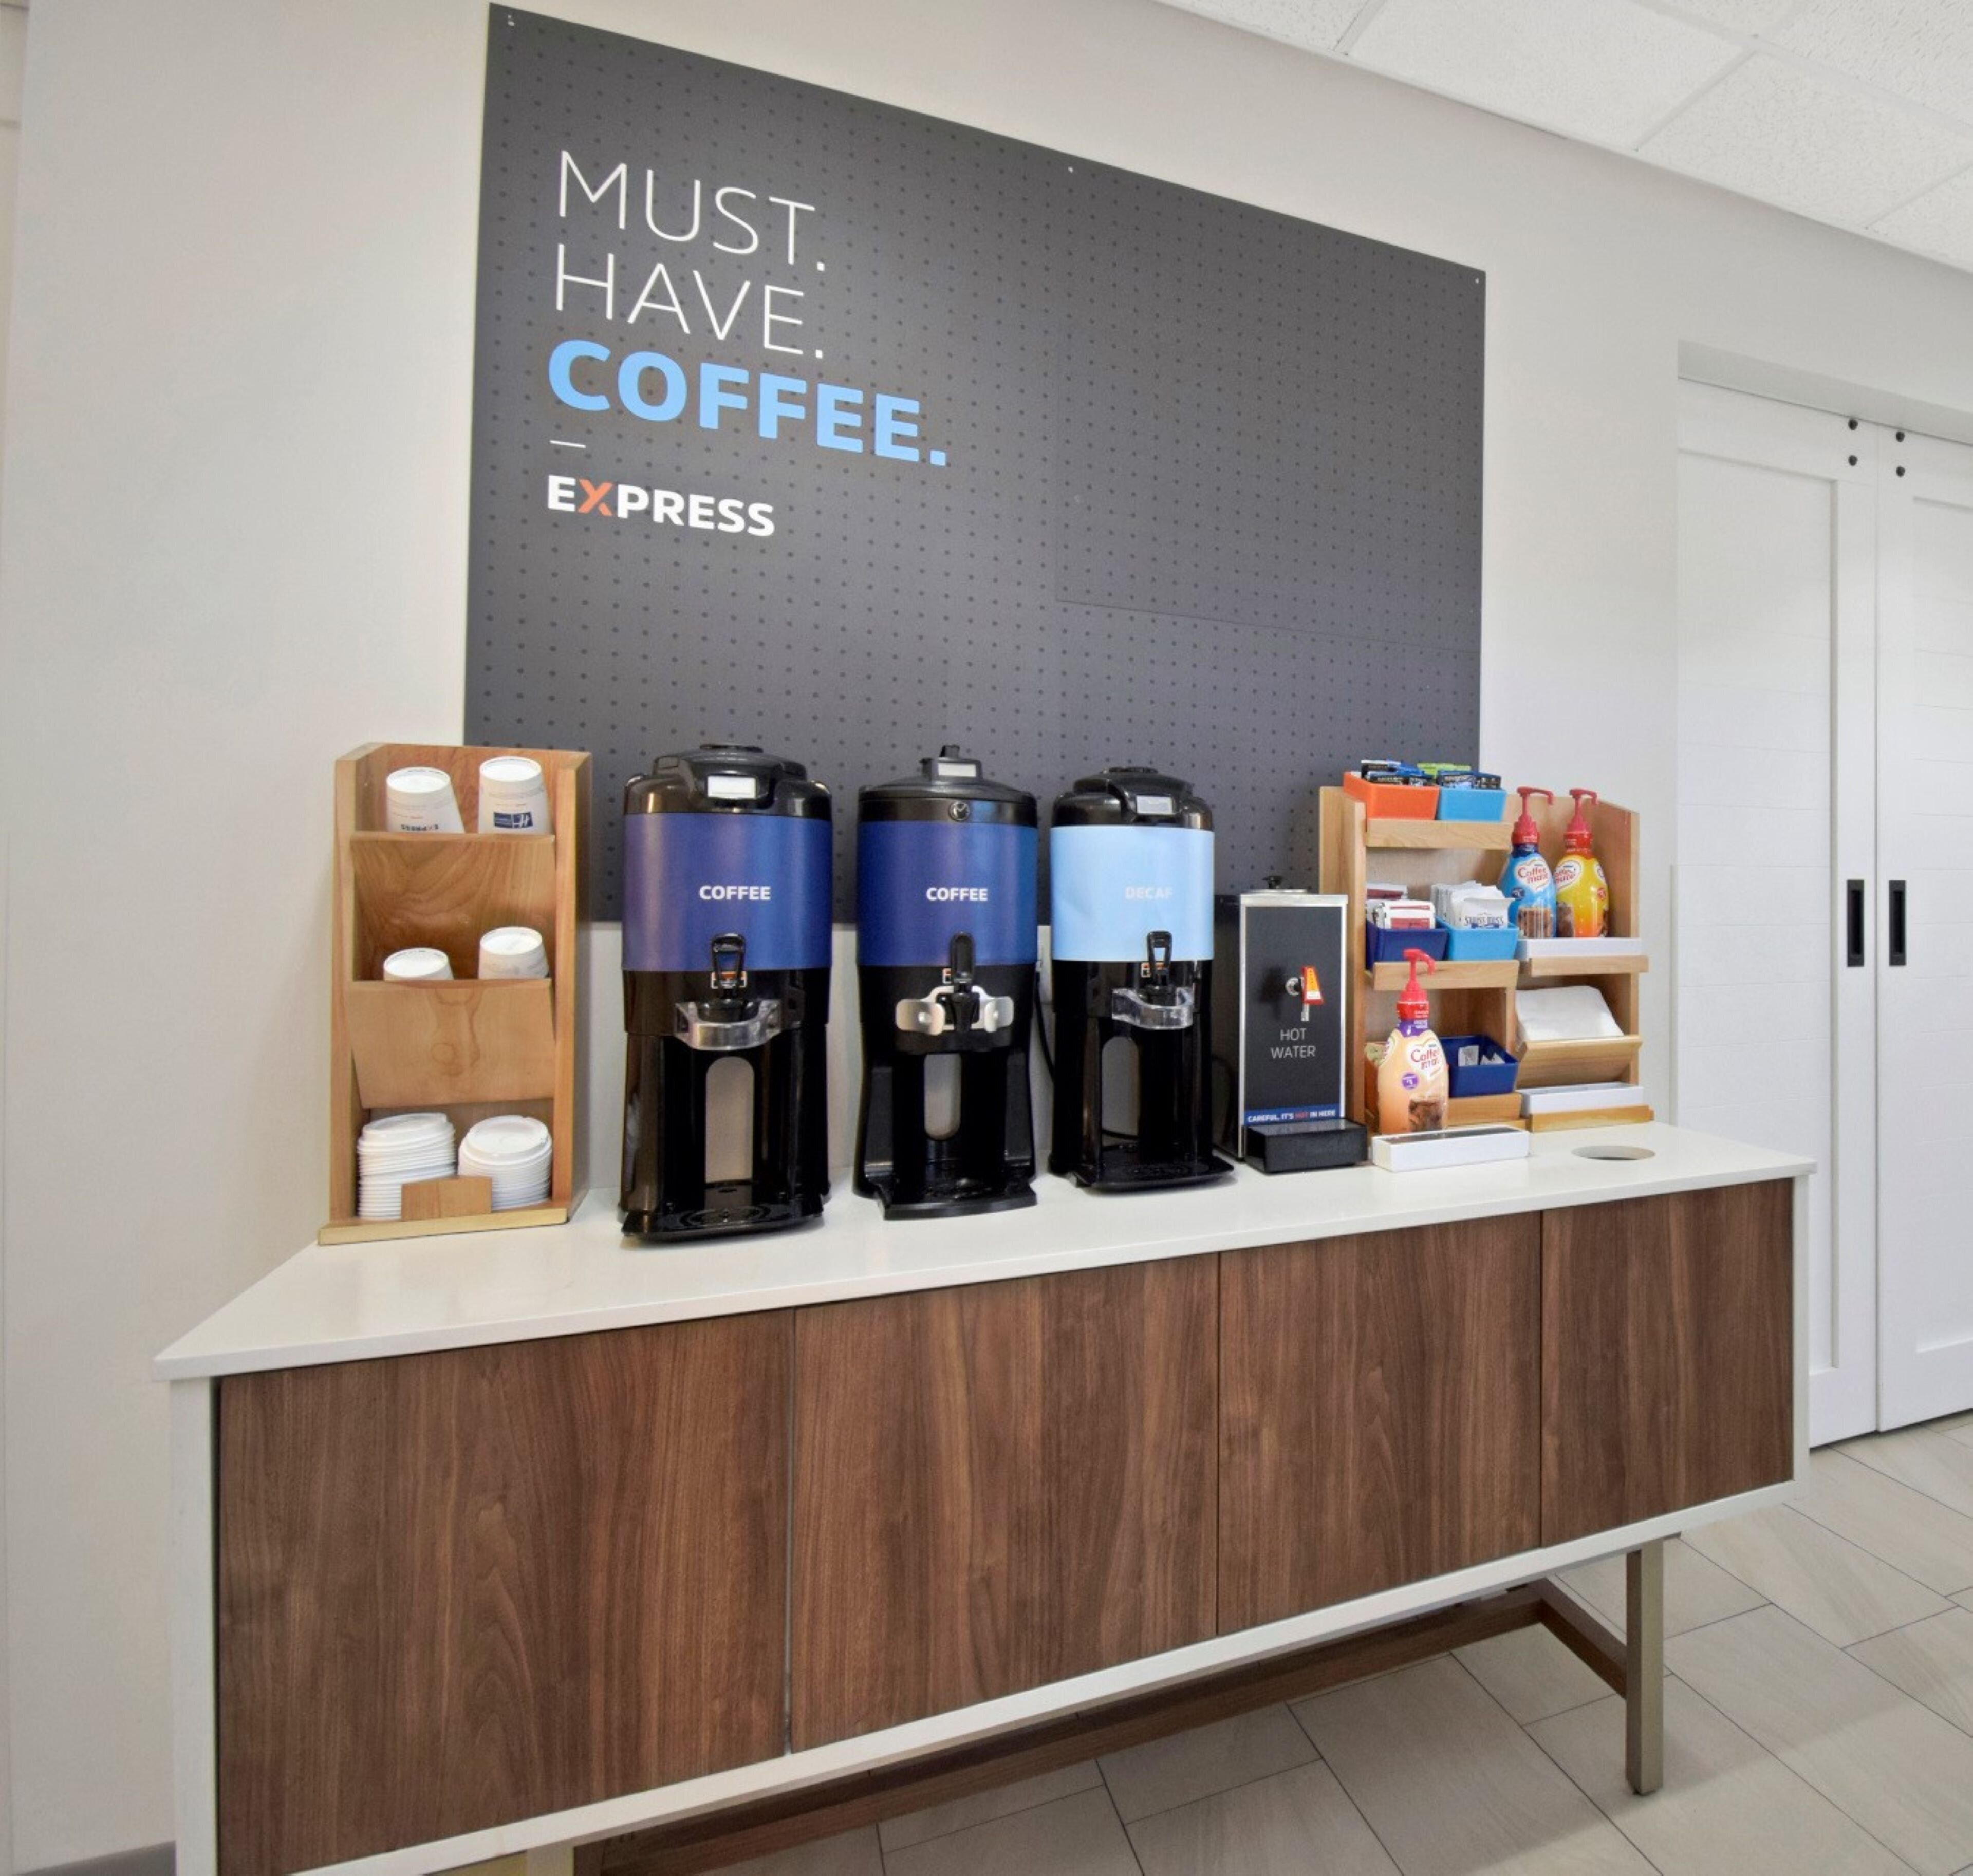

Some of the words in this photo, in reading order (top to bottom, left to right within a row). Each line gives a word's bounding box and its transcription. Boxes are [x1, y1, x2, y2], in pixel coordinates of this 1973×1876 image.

[560, 150, 825, 271] MUST.
[556, 243, 824, 359] HAVE.
[548, 339, 946, 466] COFFEE.
[547, 474, 775, 537] EXPRESS
[699, 886, 771, 900] COFFEE
[926, 887, 988, 902] COFFEE
[1125, 887, 1173, 900] DECAF
[1280, 1028, 1307, 1041] HOT
[1271, 1045, 1316, 1059] WATER
[1295, 1111, 1309, 1119] HOT
